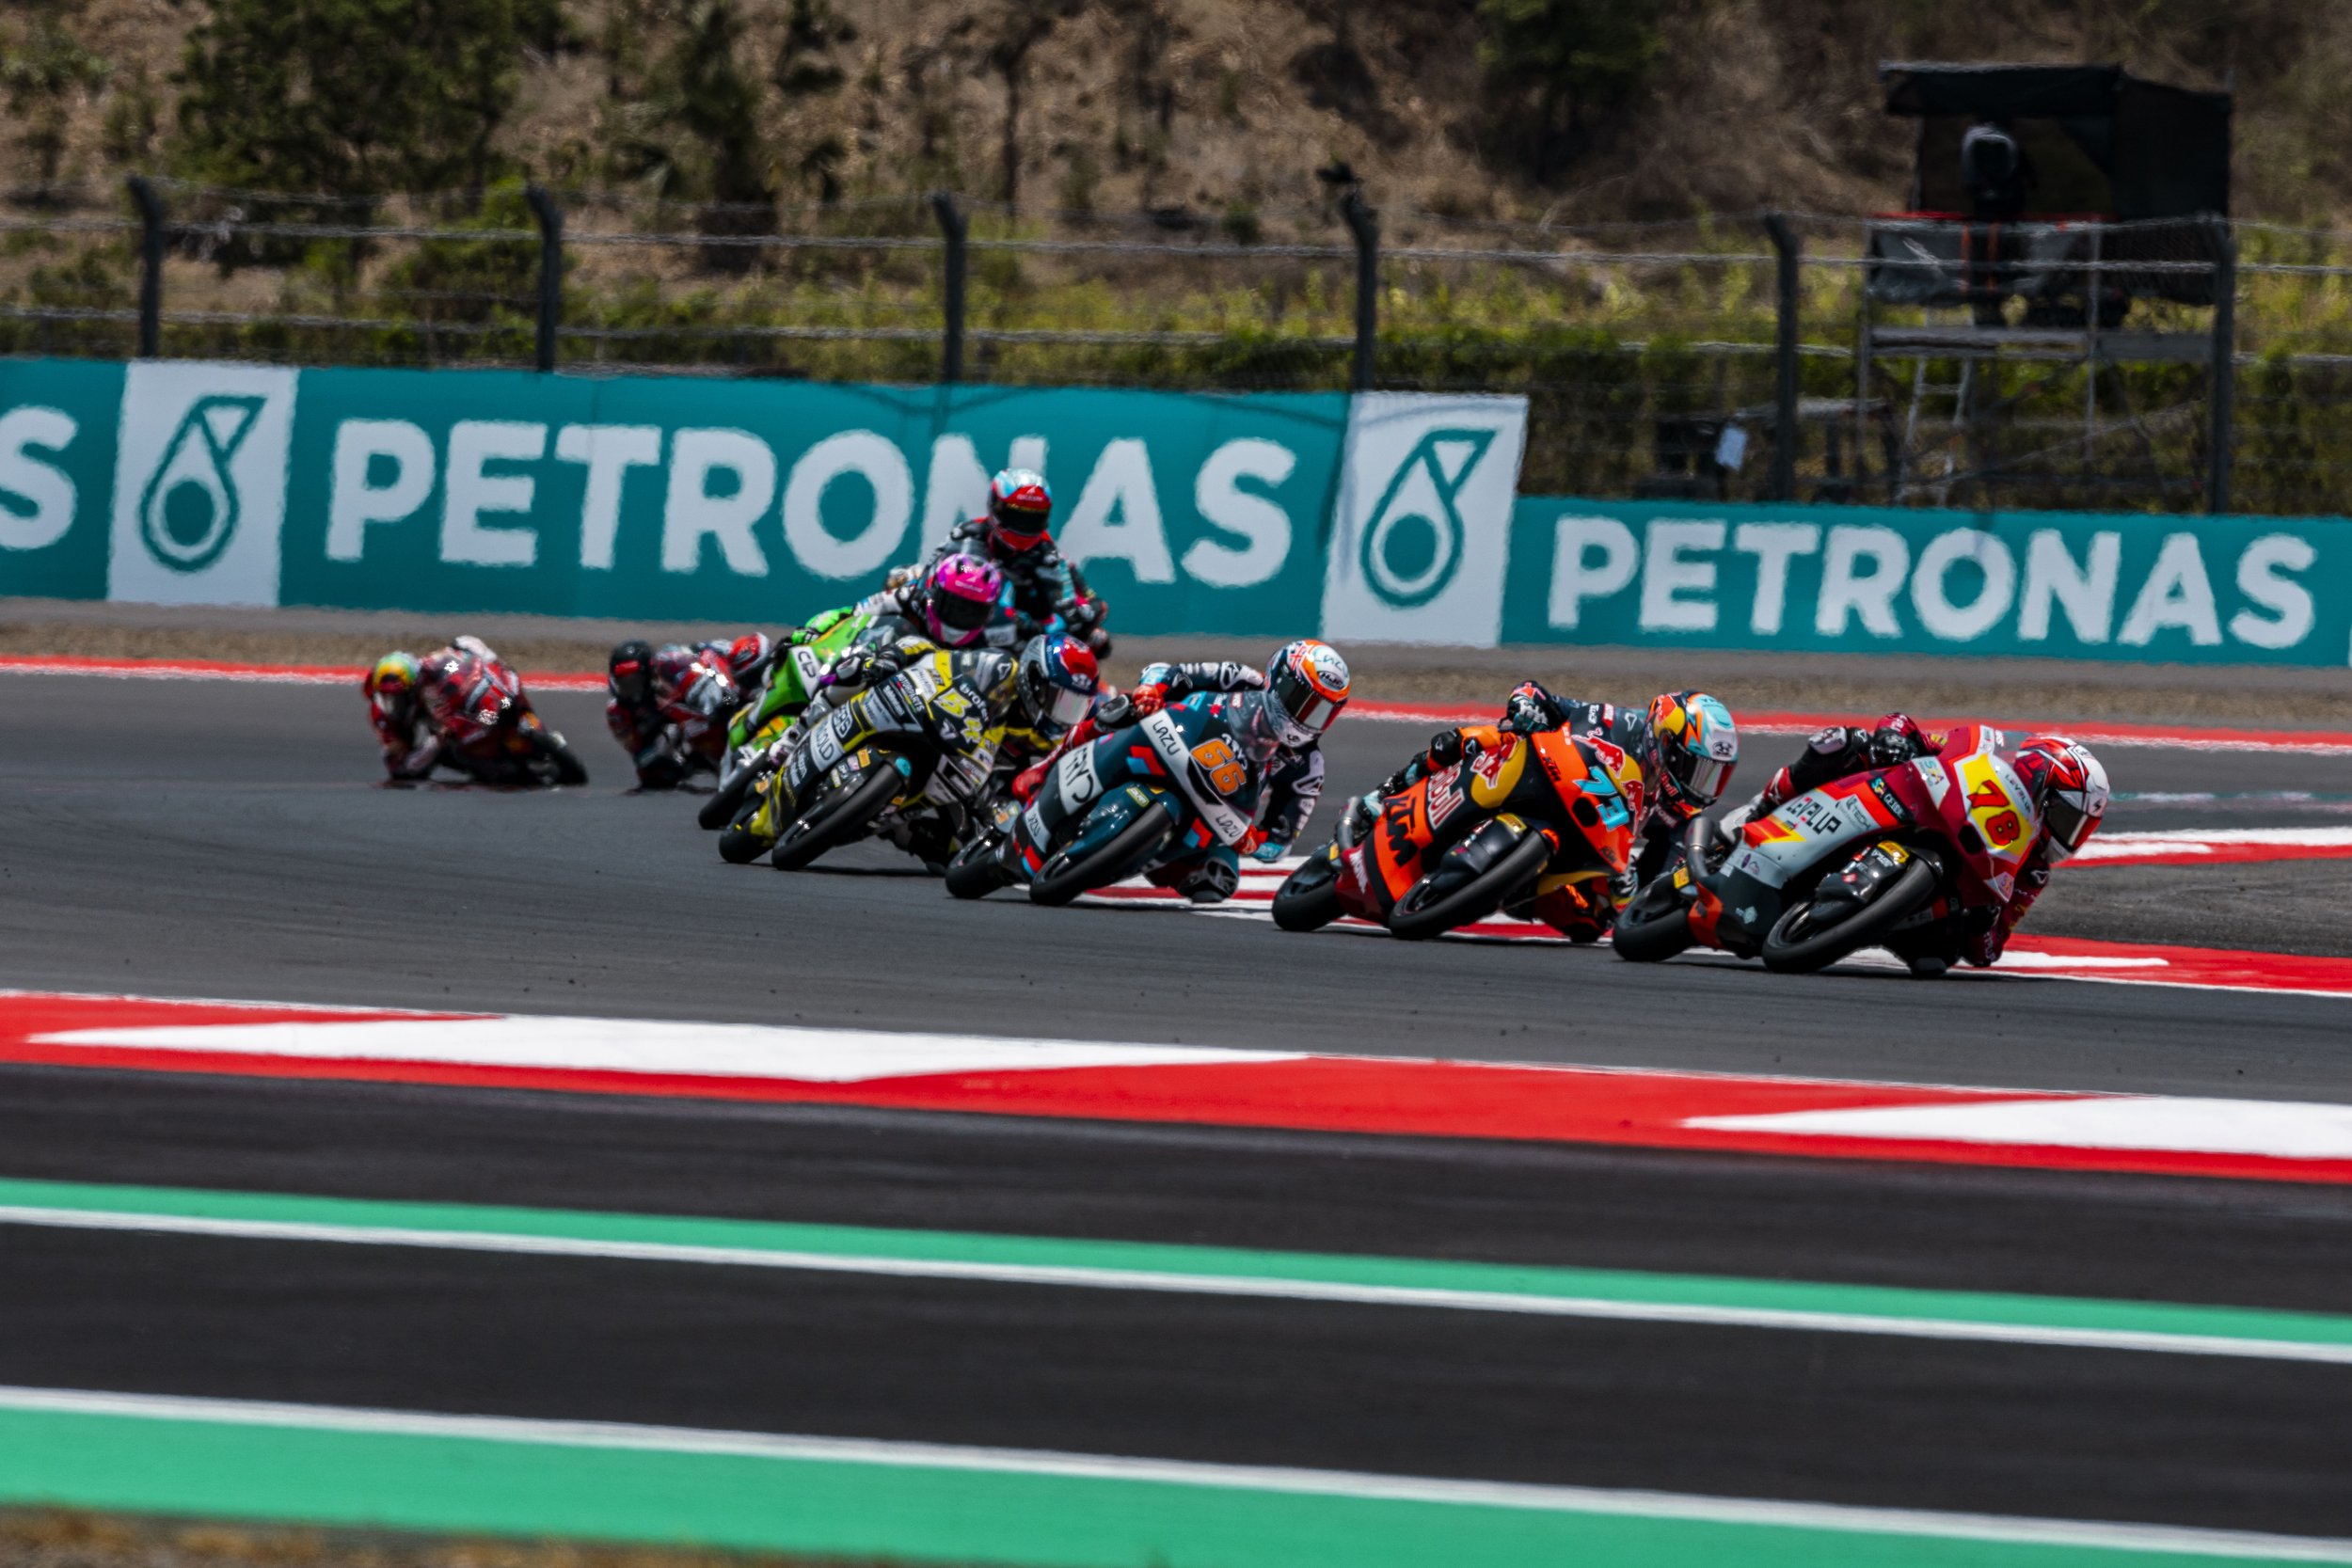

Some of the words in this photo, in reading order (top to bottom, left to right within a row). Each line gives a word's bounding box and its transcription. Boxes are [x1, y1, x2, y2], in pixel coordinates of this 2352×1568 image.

[325, 417, 1296, 588] PETRONAS
[1548, 513, 2317, 649] PETRONAS
[933, 688, 983, 744] 54
[1152, 720, 1181, 756] LAZU
[1190, 737, 1247, 796] 66
[2005, 774, 2032, 815] LEVELUP
[1027, 814, 1041, 837] AZU
[1216, 814, 1243, 838] LAZU
[1572, 766, 1629, 832] 73
[1967, 779, 2021, 847] 78
[1384, 793, 1418, 867] KTM
[1349, 847, 1369, 894] MOTUL
